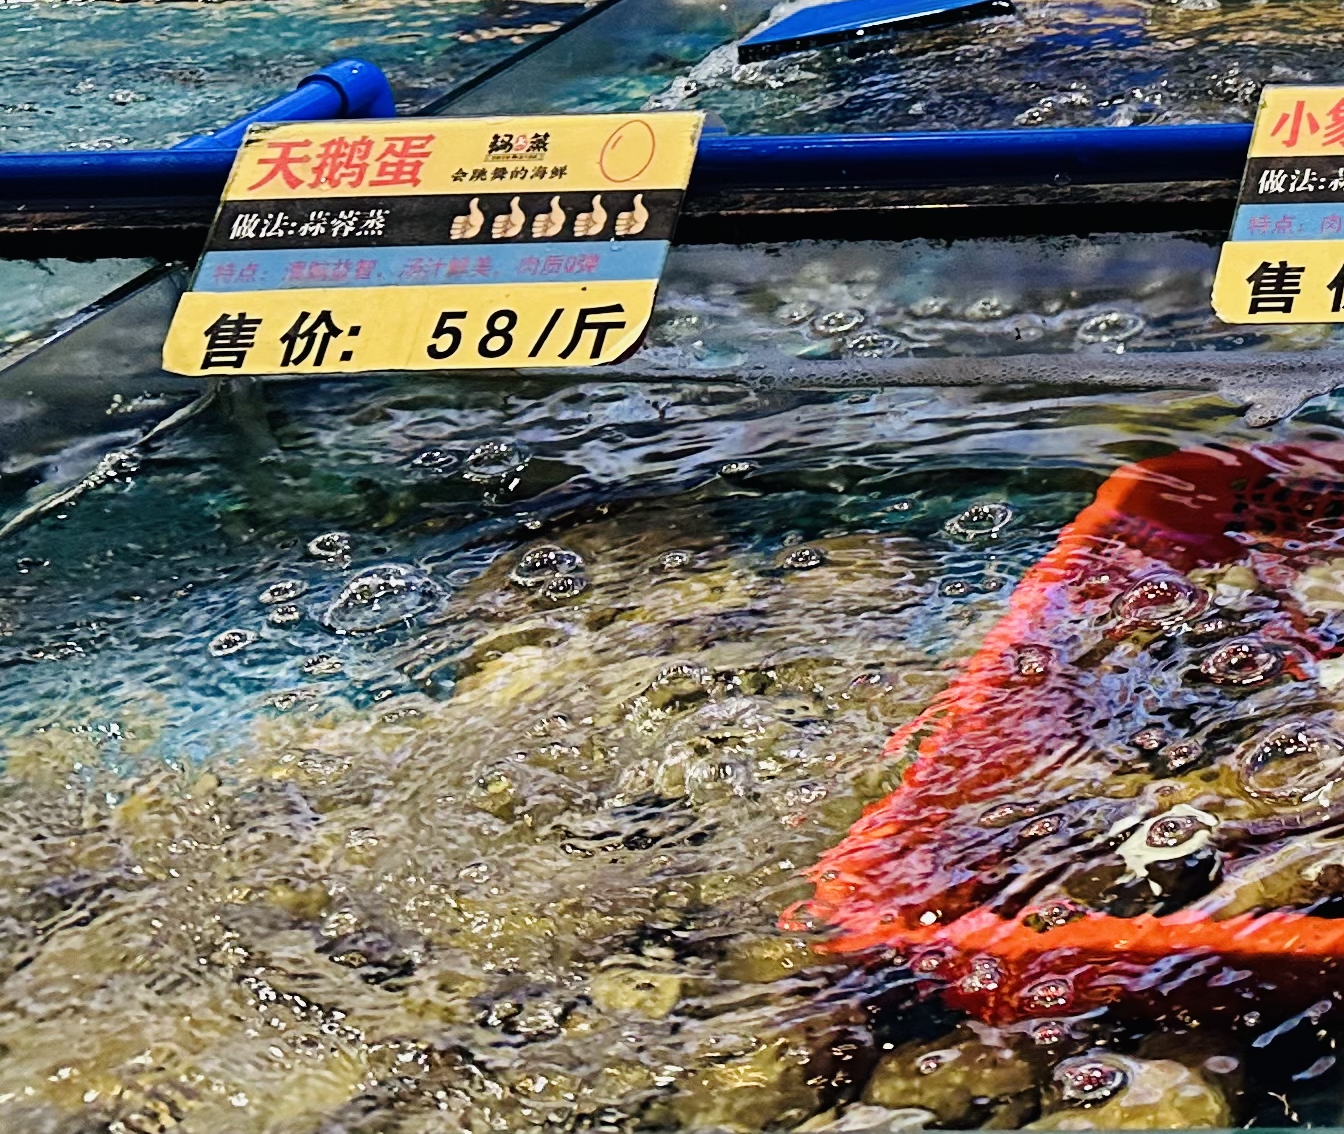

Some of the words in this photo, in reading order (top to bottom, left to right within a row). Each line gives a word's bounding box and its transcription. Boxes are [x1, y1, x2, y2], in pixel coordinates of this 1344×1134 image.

[247, 134, 436, 192] 天鹅蛋
[451, 165, 568, 182] 会跳舞的海鲜
[229, 209, 391, 240] 做法:蒜蓉蒸
